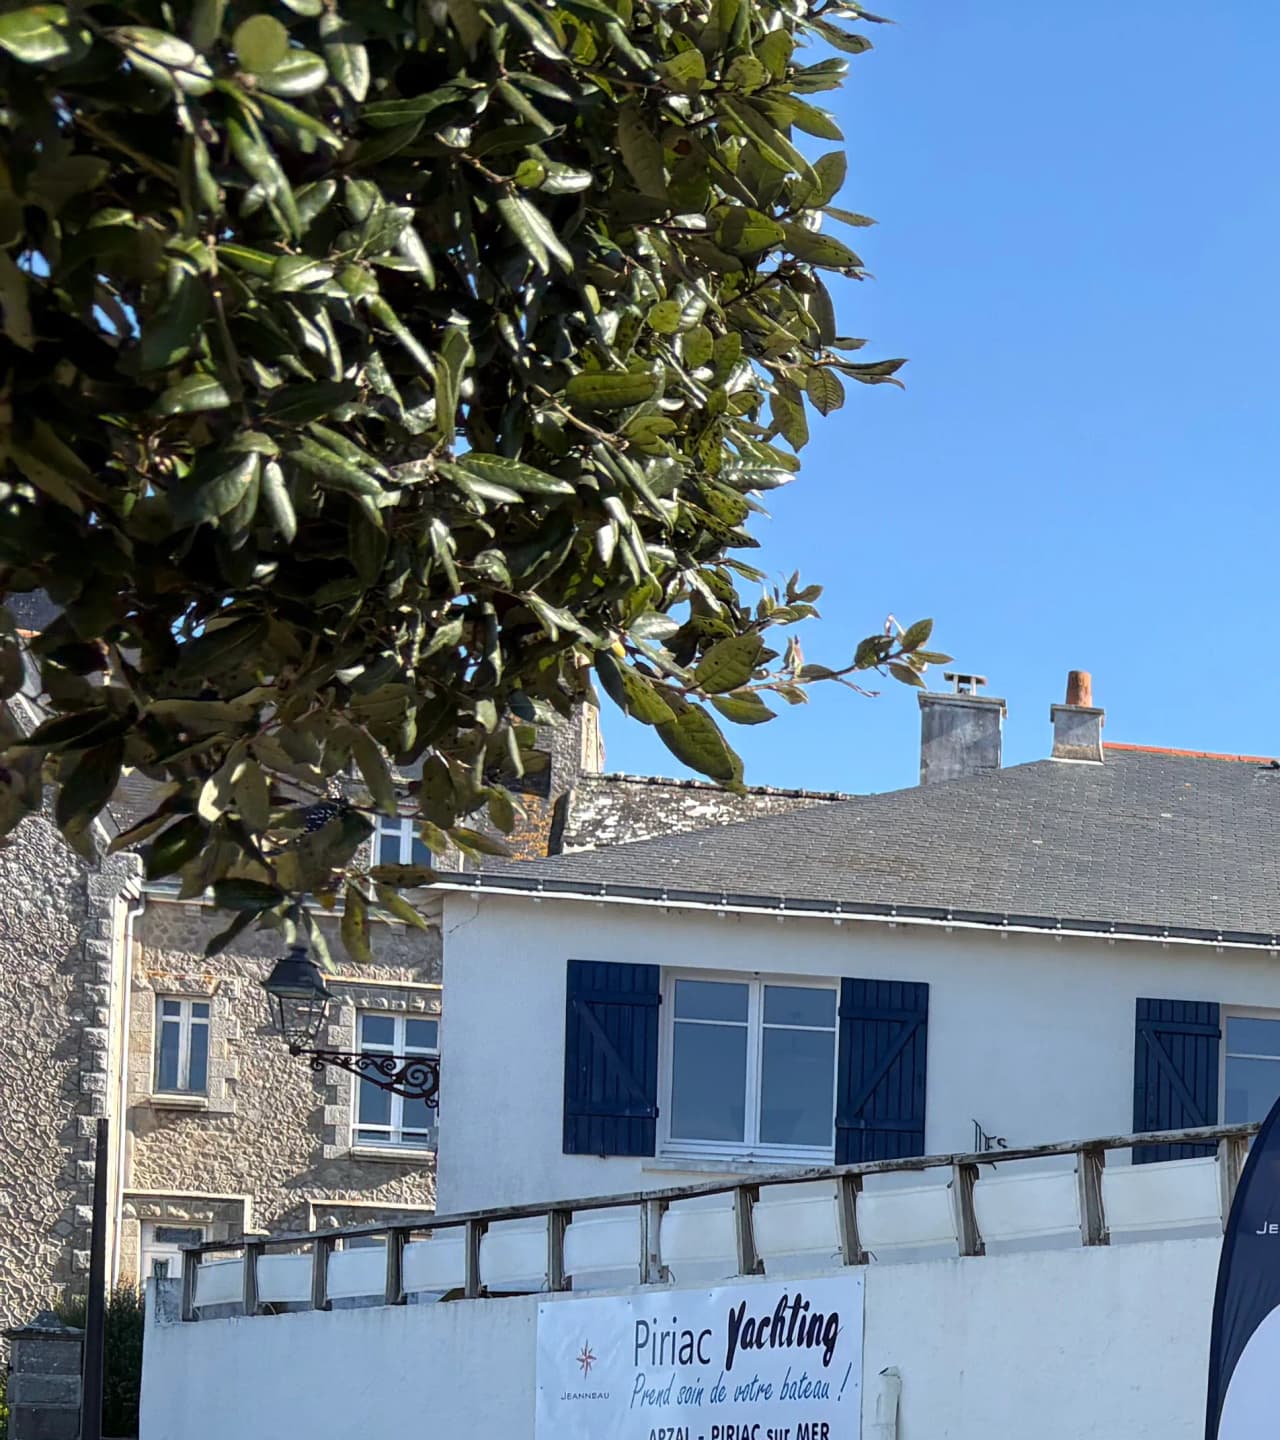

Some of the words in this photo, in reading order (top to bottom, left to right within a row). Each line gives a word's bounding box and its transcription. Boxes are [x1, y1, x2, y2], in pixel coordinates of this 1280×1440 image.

[634, 1317, 712, 1367] Piriac
[725, 1293, 843, 1371] Yachting
[561, 1391, 610, 1400] JEANNEAU
[630, 1372, 675, 1408] Prend
[677, 1377, 703, 1406] soin
[710, 1371, 726, 1402] de
[734, 1374, 774, 1402] votre
[780, 1366, 830, 1401] bateau
